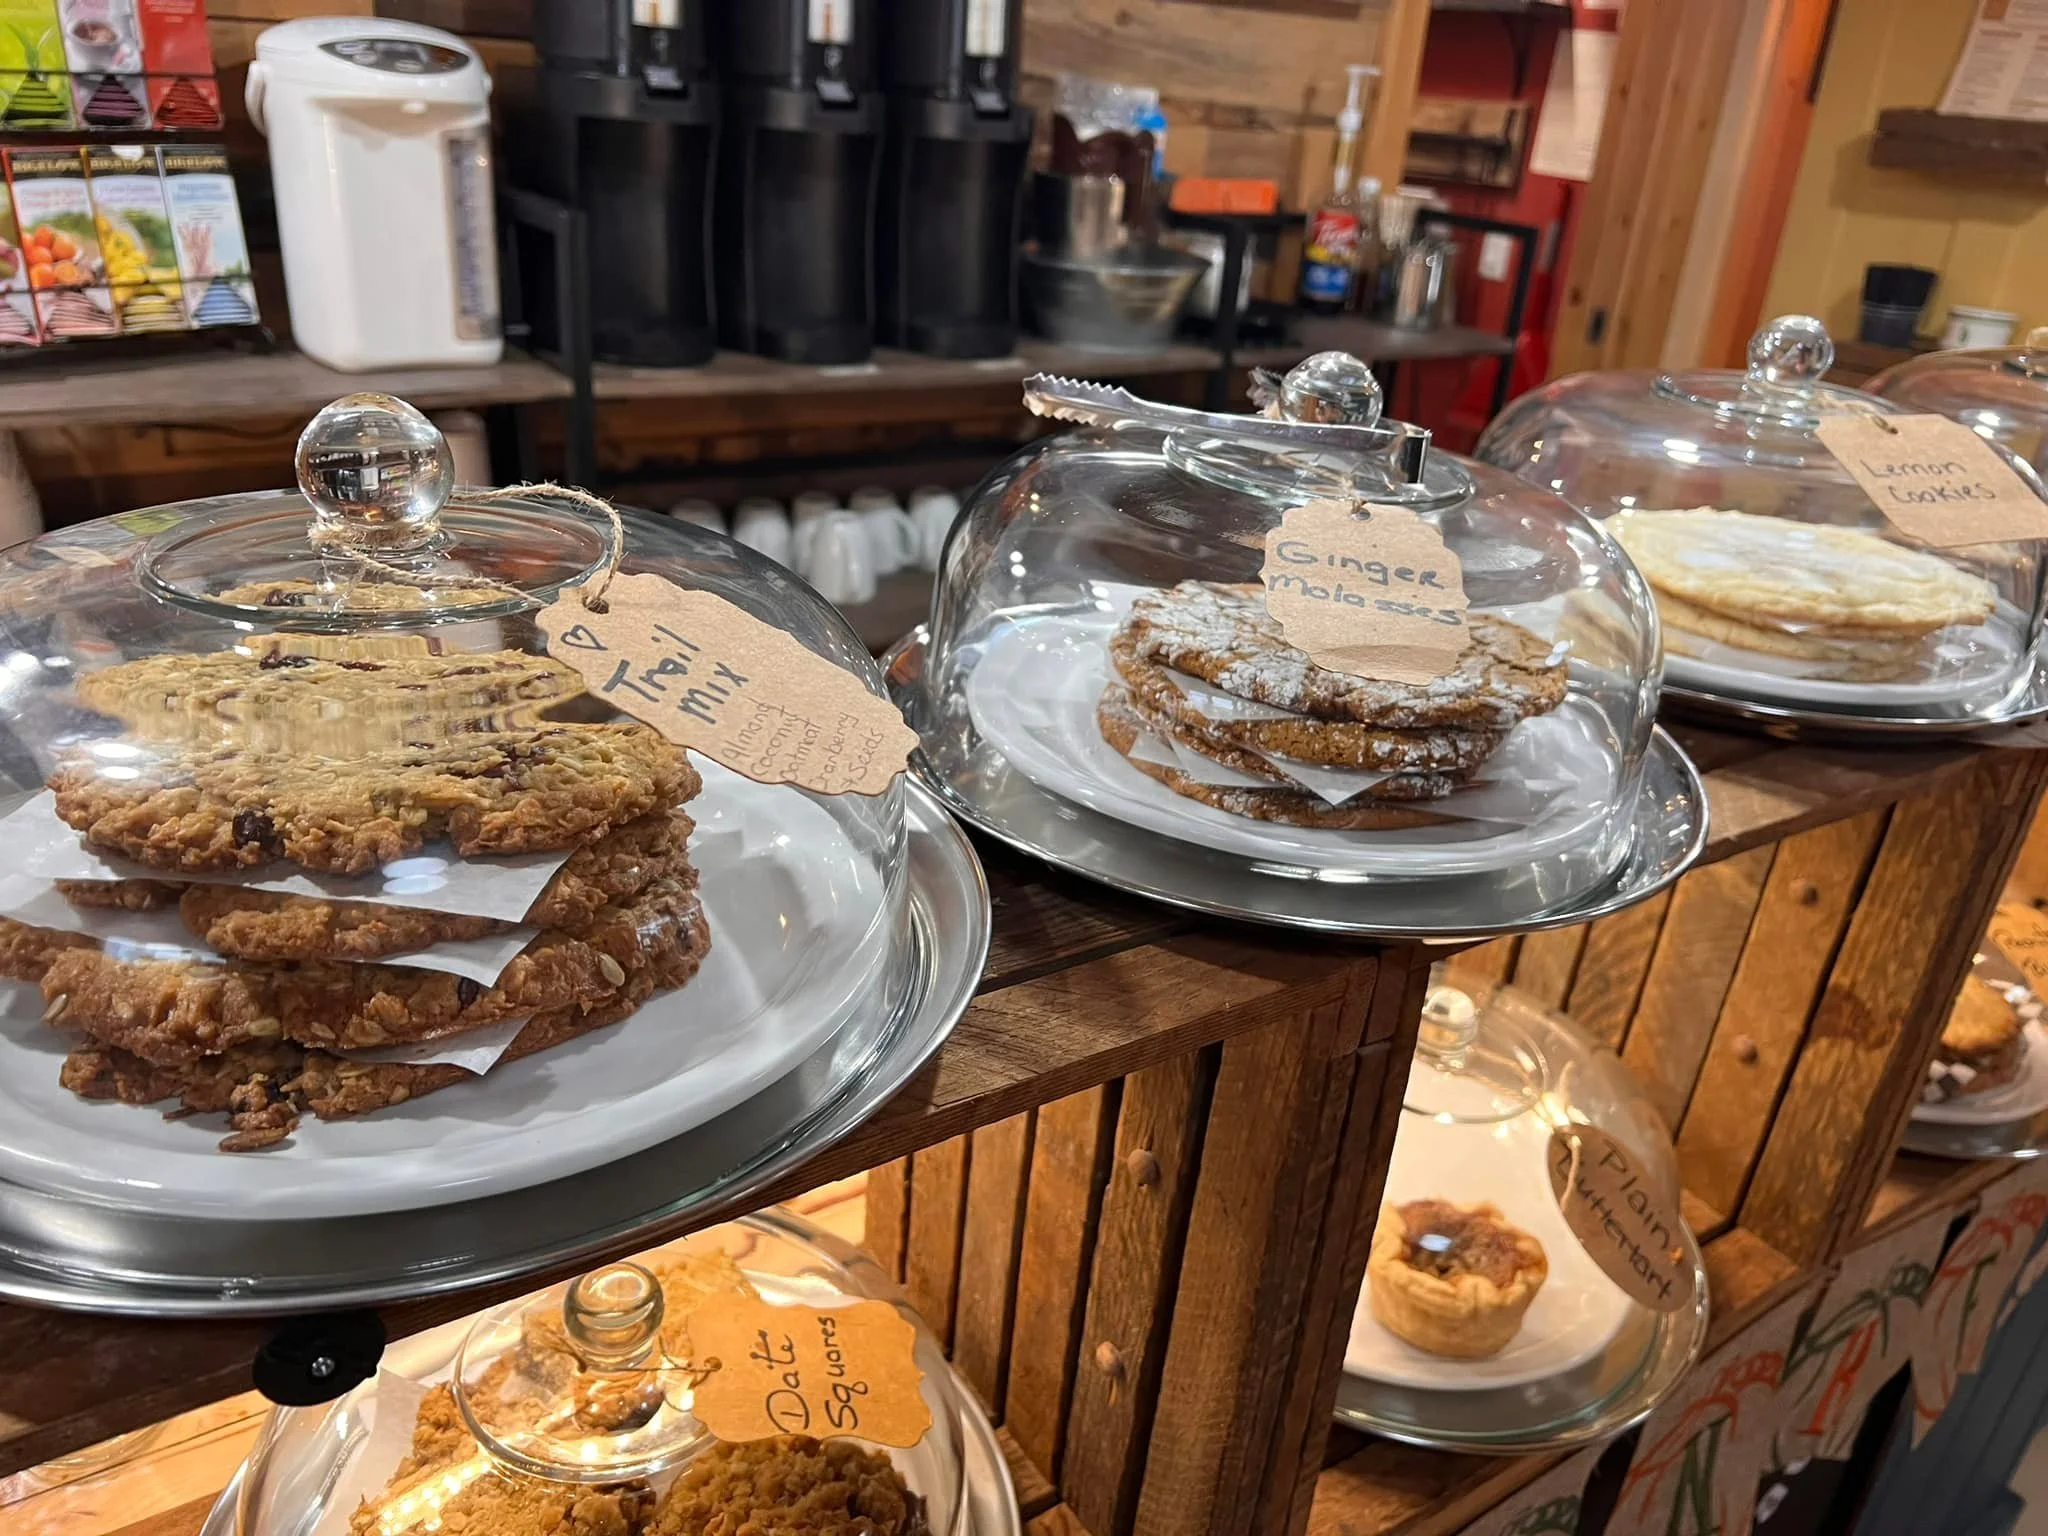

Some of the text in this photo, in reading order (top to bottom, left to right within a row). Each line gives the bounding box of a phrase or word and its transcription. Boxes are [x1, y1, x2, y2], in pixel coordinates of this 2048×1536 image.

[1859, 459, 1968, 479] Lemon
[1887, 480, 1997, 504] Cookies
[601, 623, 701, 703] Trail
[721, 696, 771, 760] Almond
[750, 704, 797, 777] Coconut
[1599, 1137, 1671, 1250] Plain
[750, 1329, 810, 1433] Date
